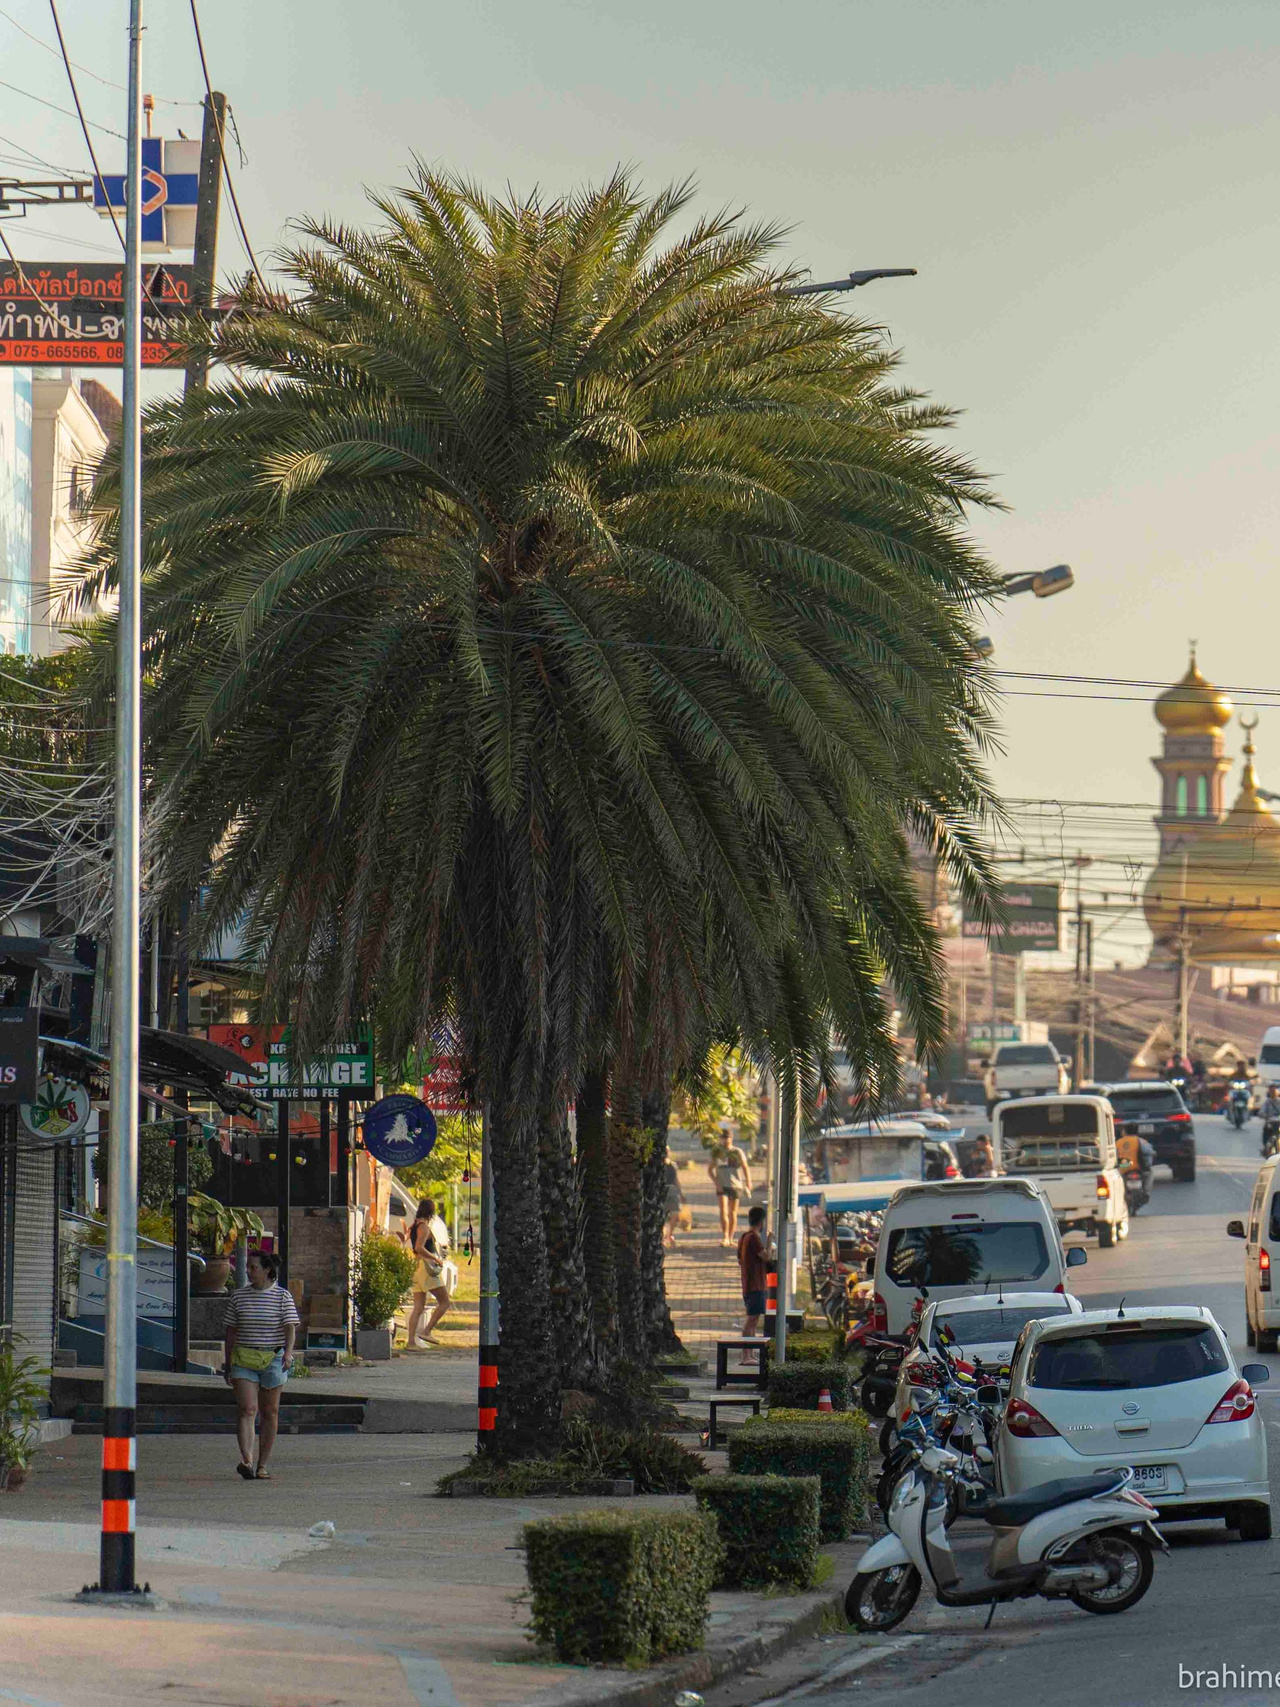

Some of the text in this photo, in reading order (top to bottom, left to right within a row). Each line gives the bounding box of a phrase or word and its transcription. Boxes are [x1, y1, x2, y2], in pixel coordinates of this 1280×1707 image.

[246, 1088, 268, 1098] EST
[303, 1088, 318, 1098] NO
[322, 1088, 339, 1098] FEE
[1134, 1467, 1163, 1481] 8603
